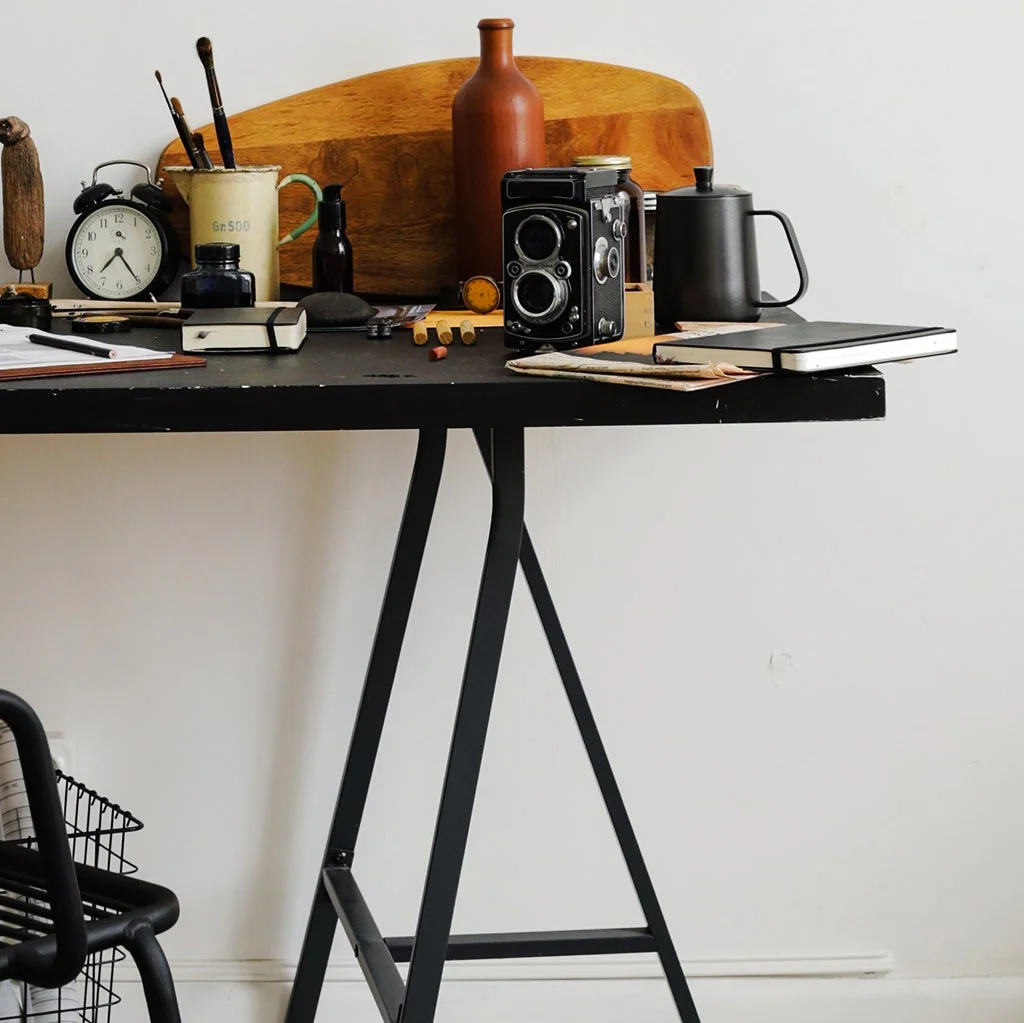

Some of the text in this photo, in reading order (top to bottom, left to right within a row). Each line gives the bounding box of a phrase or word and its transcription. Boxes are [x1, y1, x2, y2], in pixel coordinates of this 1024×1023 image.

[99, 218, 108, 228] 11
[114, 213, 124, 224] 12
[87, 231, 97, 241] 10
[144, 229, 152, 239] 2
[81, 248, 89, 258] 9
[150, 245, 157, 256] 3
[86, 265, 94, 275] 8
[100, 276, 107, 287] 7
[116, 280, 123, 290] 6
